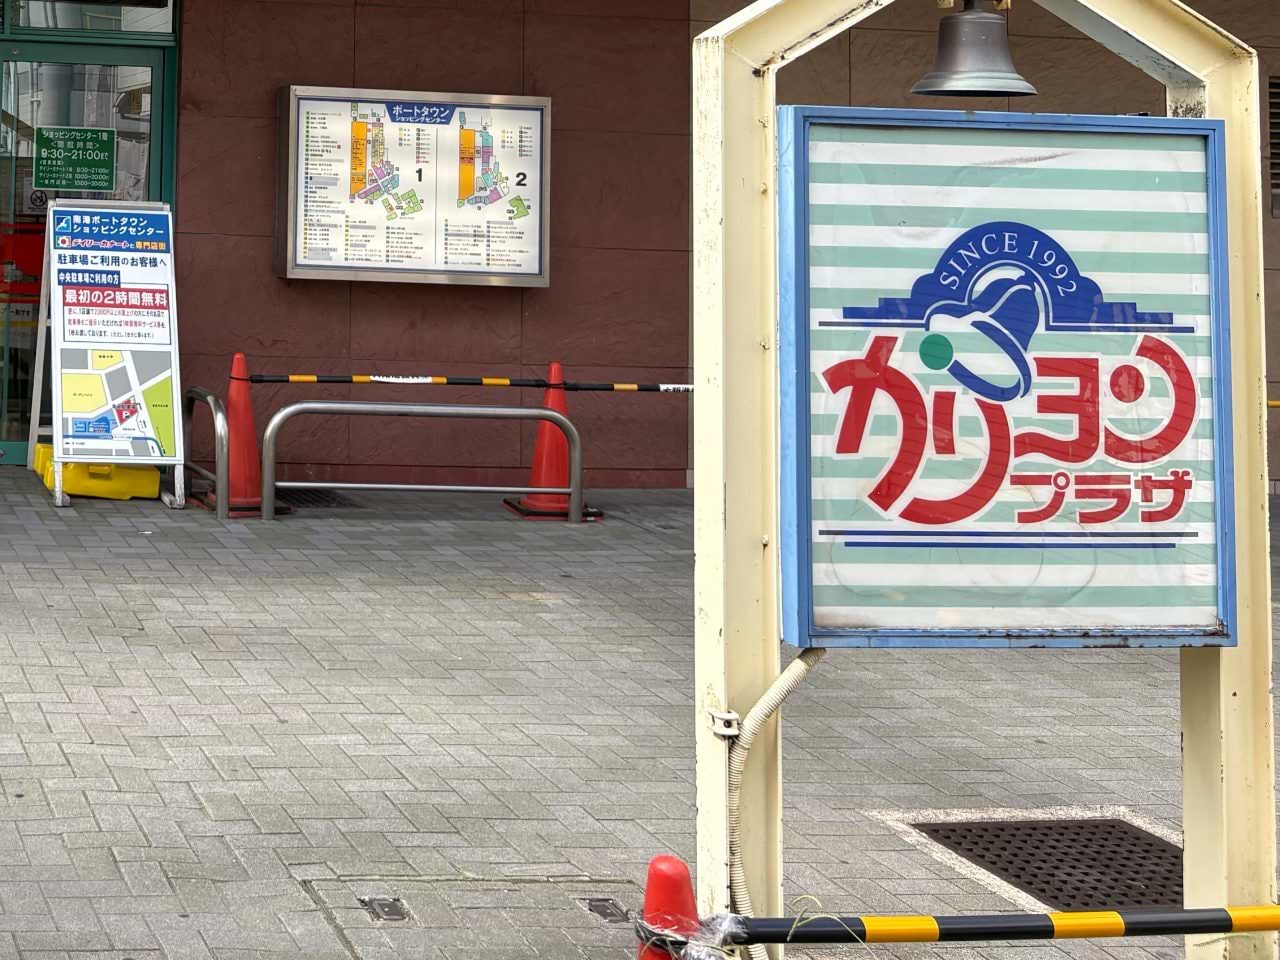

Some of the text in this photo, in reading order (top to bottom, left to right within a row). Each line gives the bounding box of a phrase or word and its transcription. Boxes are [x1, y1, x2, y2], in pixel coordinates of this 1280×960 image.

[415, 167, 423, 182] 1
[515, 172, 528, 187] 2
[72, 214, 148, 226] 南港ポートタウン
[72, 225, 164, 236] ショッピングセンター
[57, 254, 167, 268] 駐車場ご利用のお客様へ
[938, 232, 1078, 296] SINCE 1992
[64, 289, 167, 306] 最初の2時間無料
[1009, 469, 1193, 523] プラザ
